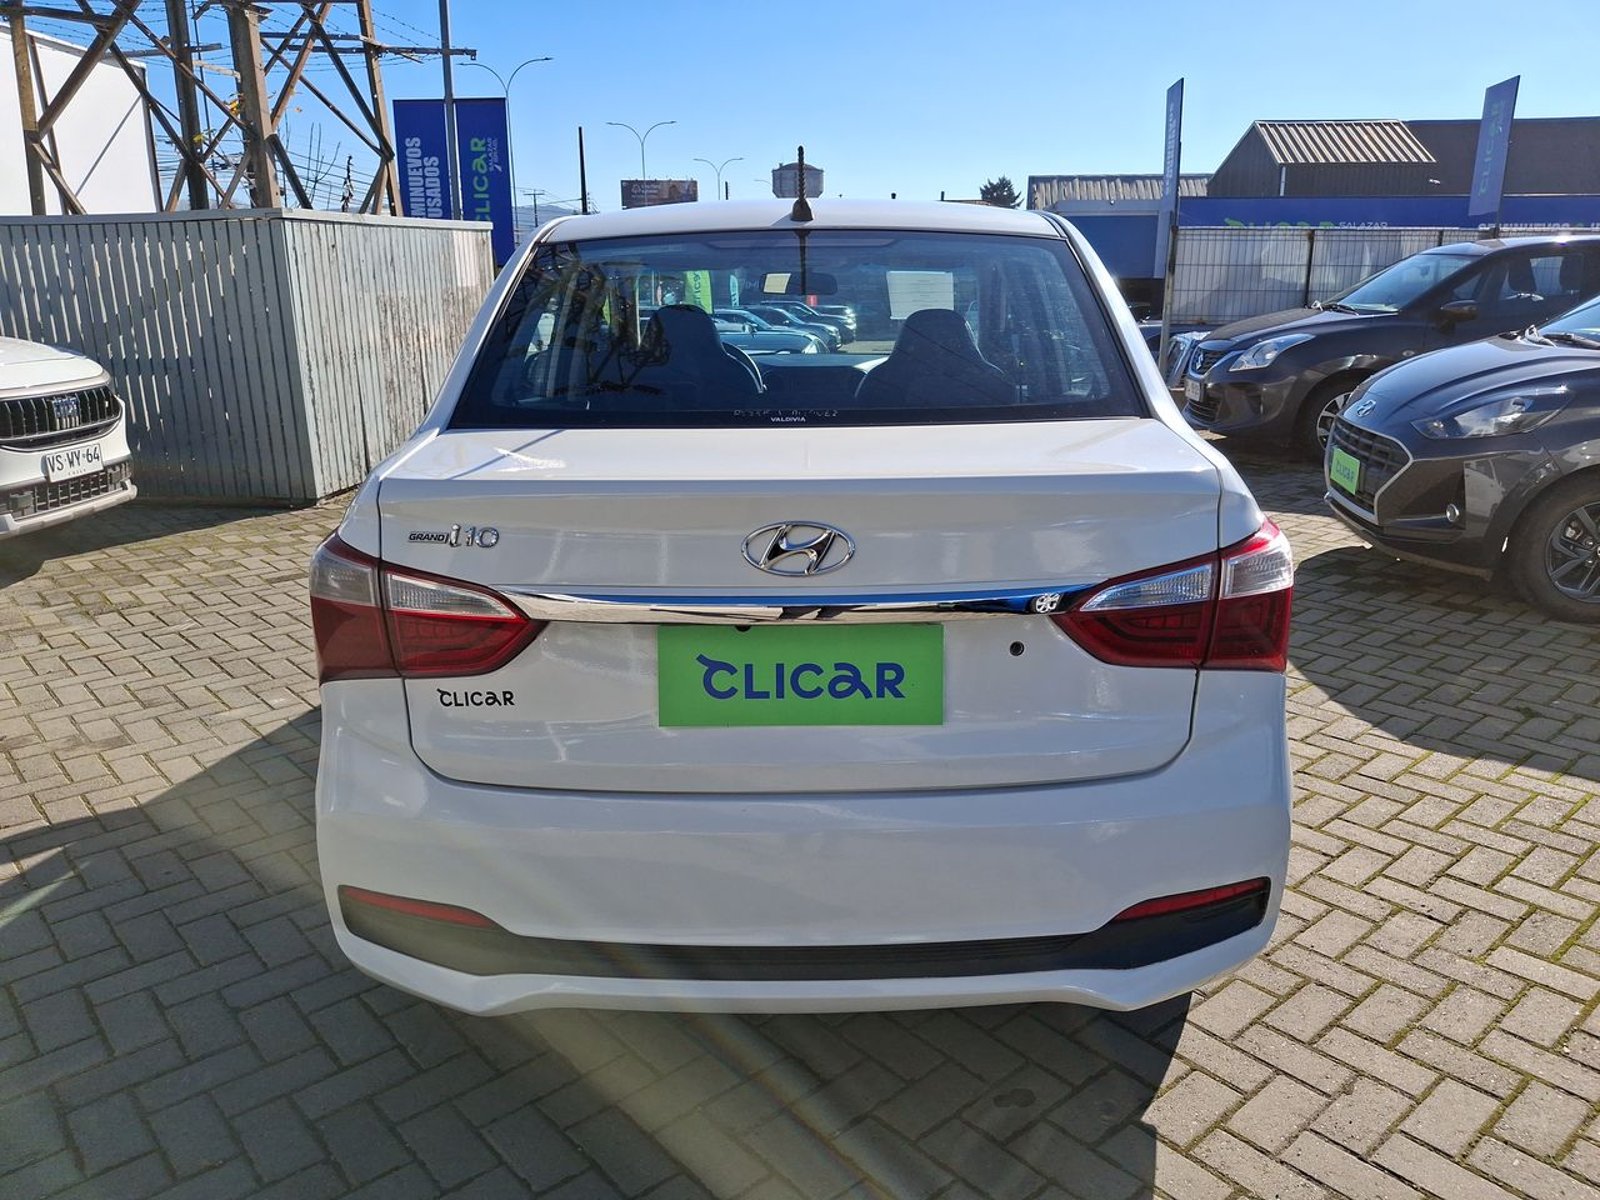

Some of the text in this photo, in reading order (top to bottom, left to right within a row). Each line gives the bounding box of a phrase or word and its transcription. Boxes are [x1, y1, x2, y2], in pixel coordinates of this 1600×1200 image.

[405, 137, 426, 219] MINUEVOS
[423, 156, 443, 218] USADOS
[408, 523, 500, 548] GRAND i10
